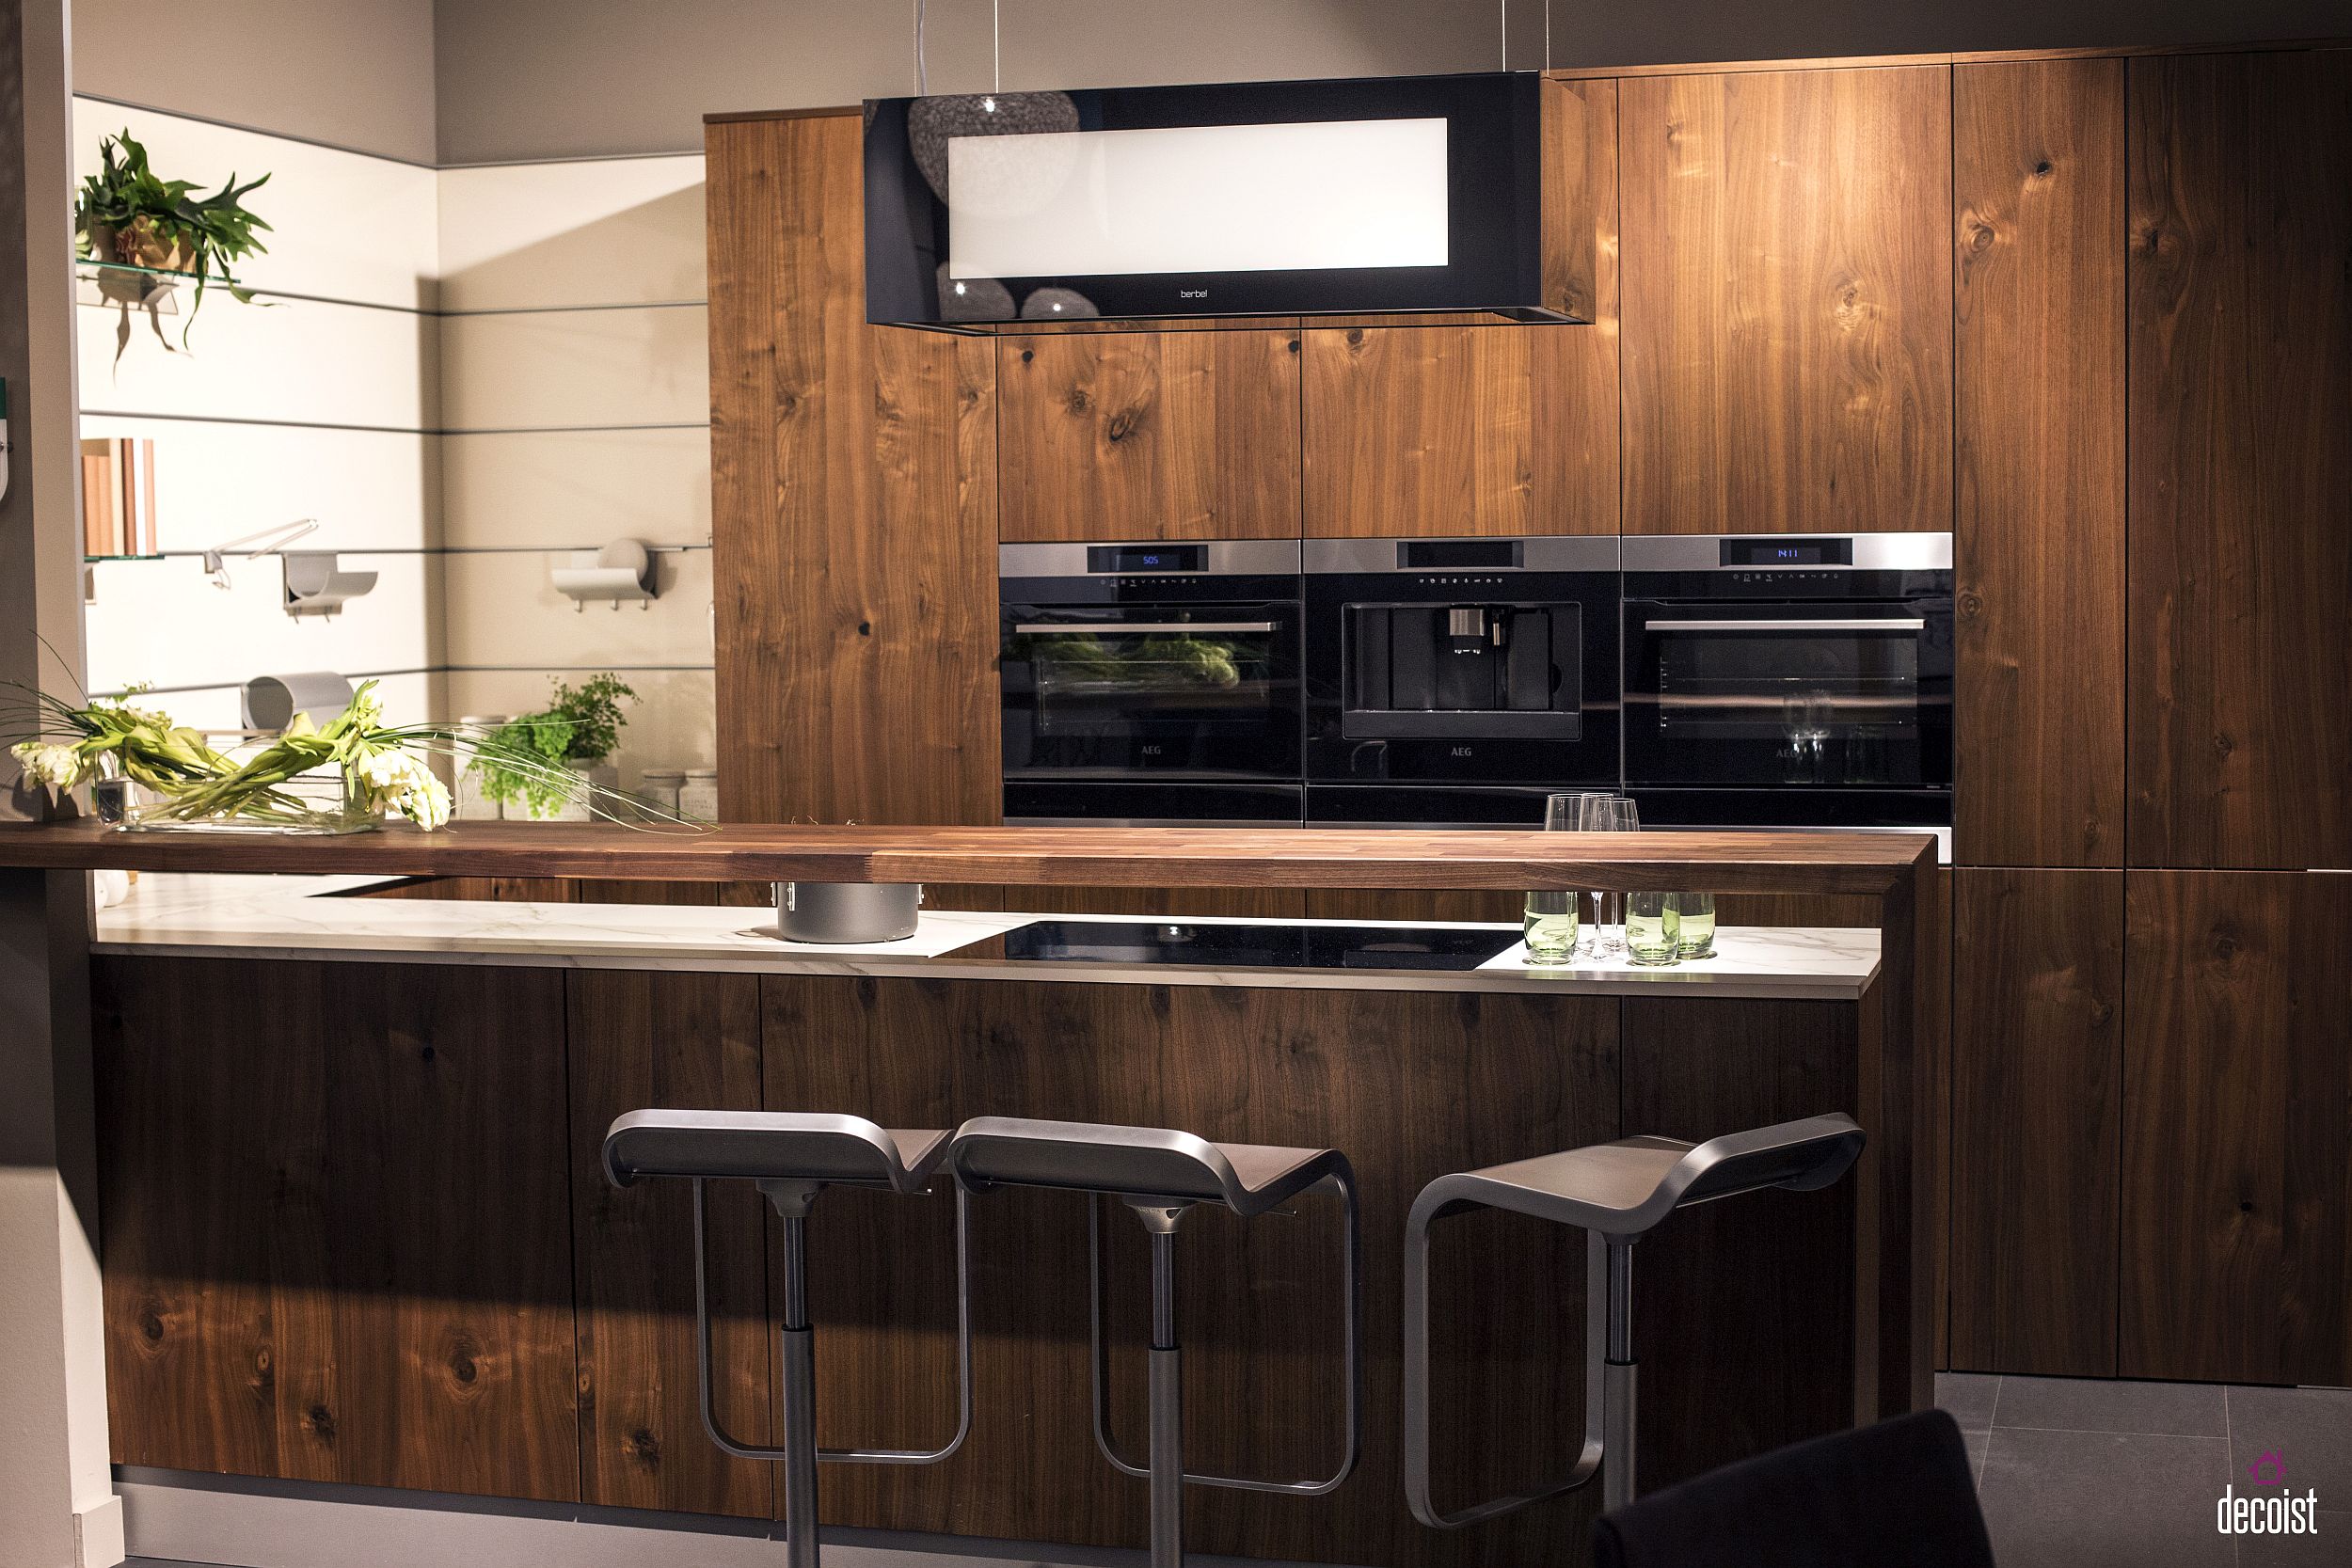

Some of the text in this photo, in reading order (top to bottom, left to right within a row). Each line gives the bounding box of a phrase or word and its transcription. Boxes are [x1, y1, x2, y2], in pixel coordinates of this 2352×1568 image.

[1180, 289, 1208, 298] berbel
[1141, 745, 1161, 755] AEG
[1451, 747, 1471, 756] AEG
